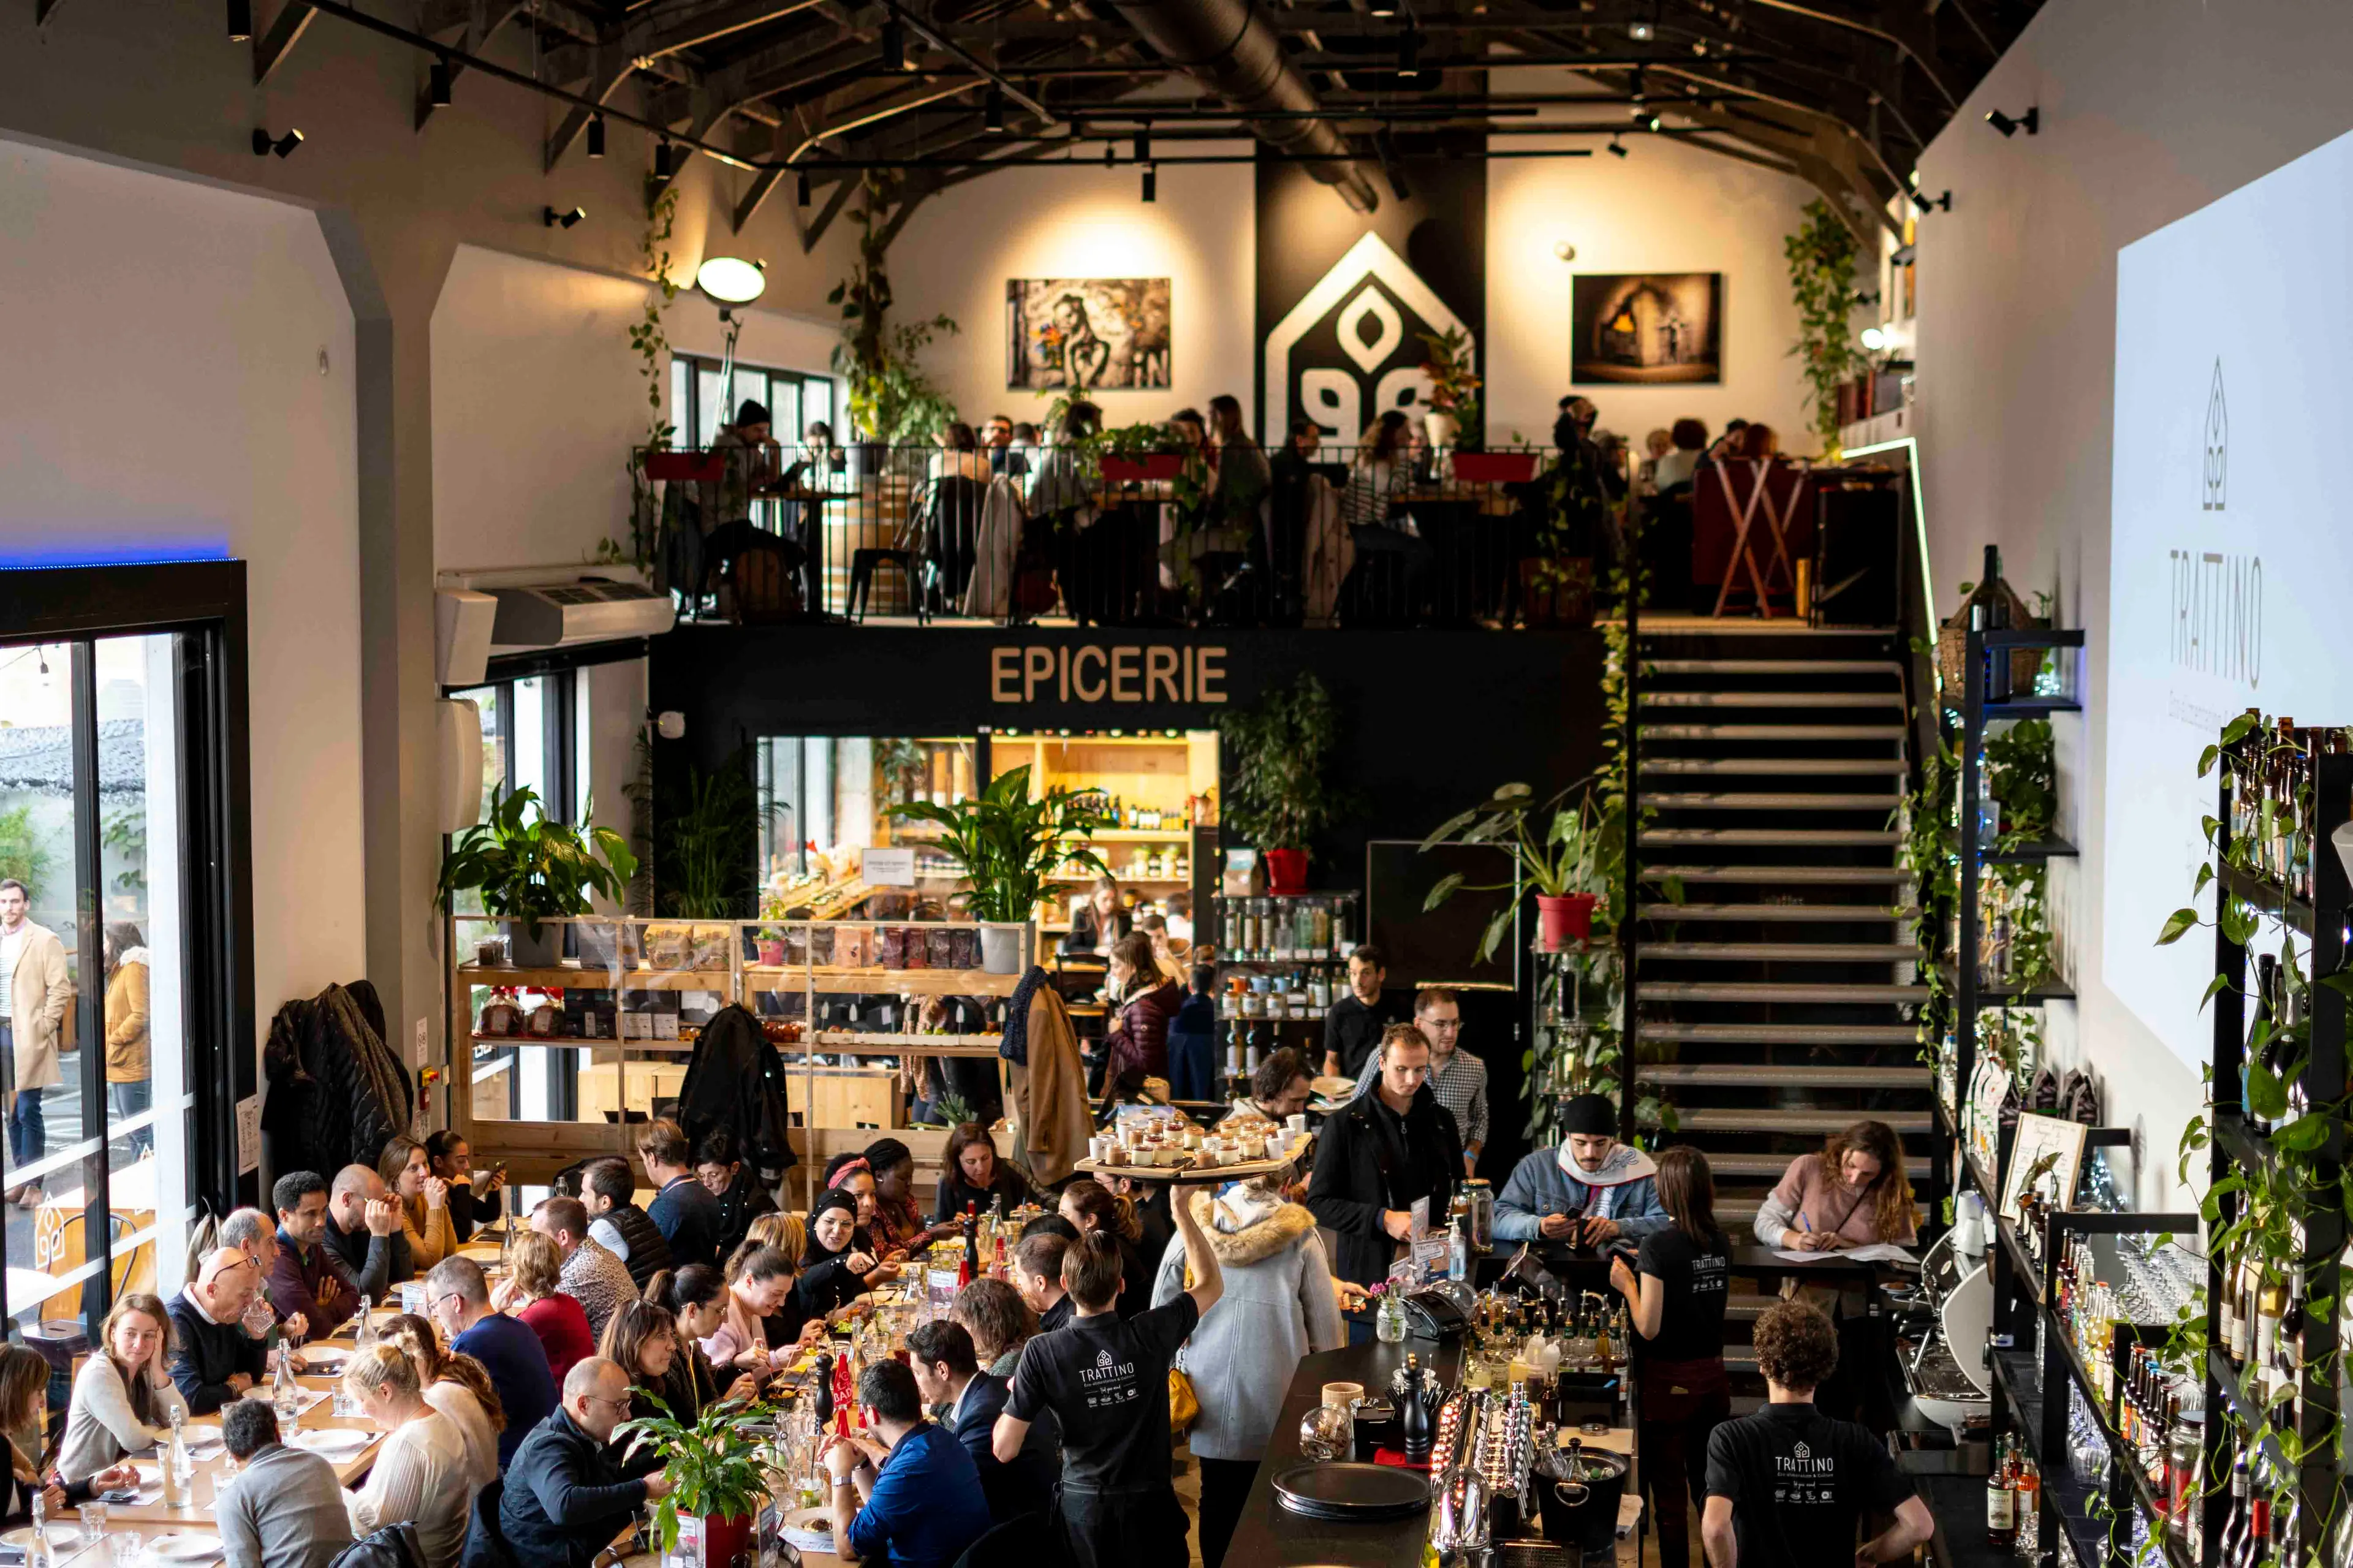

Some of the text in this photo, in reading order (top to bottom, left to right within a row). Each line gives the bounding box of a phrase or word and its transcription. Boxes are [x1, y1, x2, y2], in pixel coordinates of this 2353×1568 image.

[2170, 550, 2262, 689] TRATTINO
[991, 645, 1228, 703] EPICERIE
[1691, 1256, 1726, 1270] TRATTINO
[1079, 1362, 1134, 1382] TRATTINO
[1775, 1456, 1834, 1473] TRATTINO
